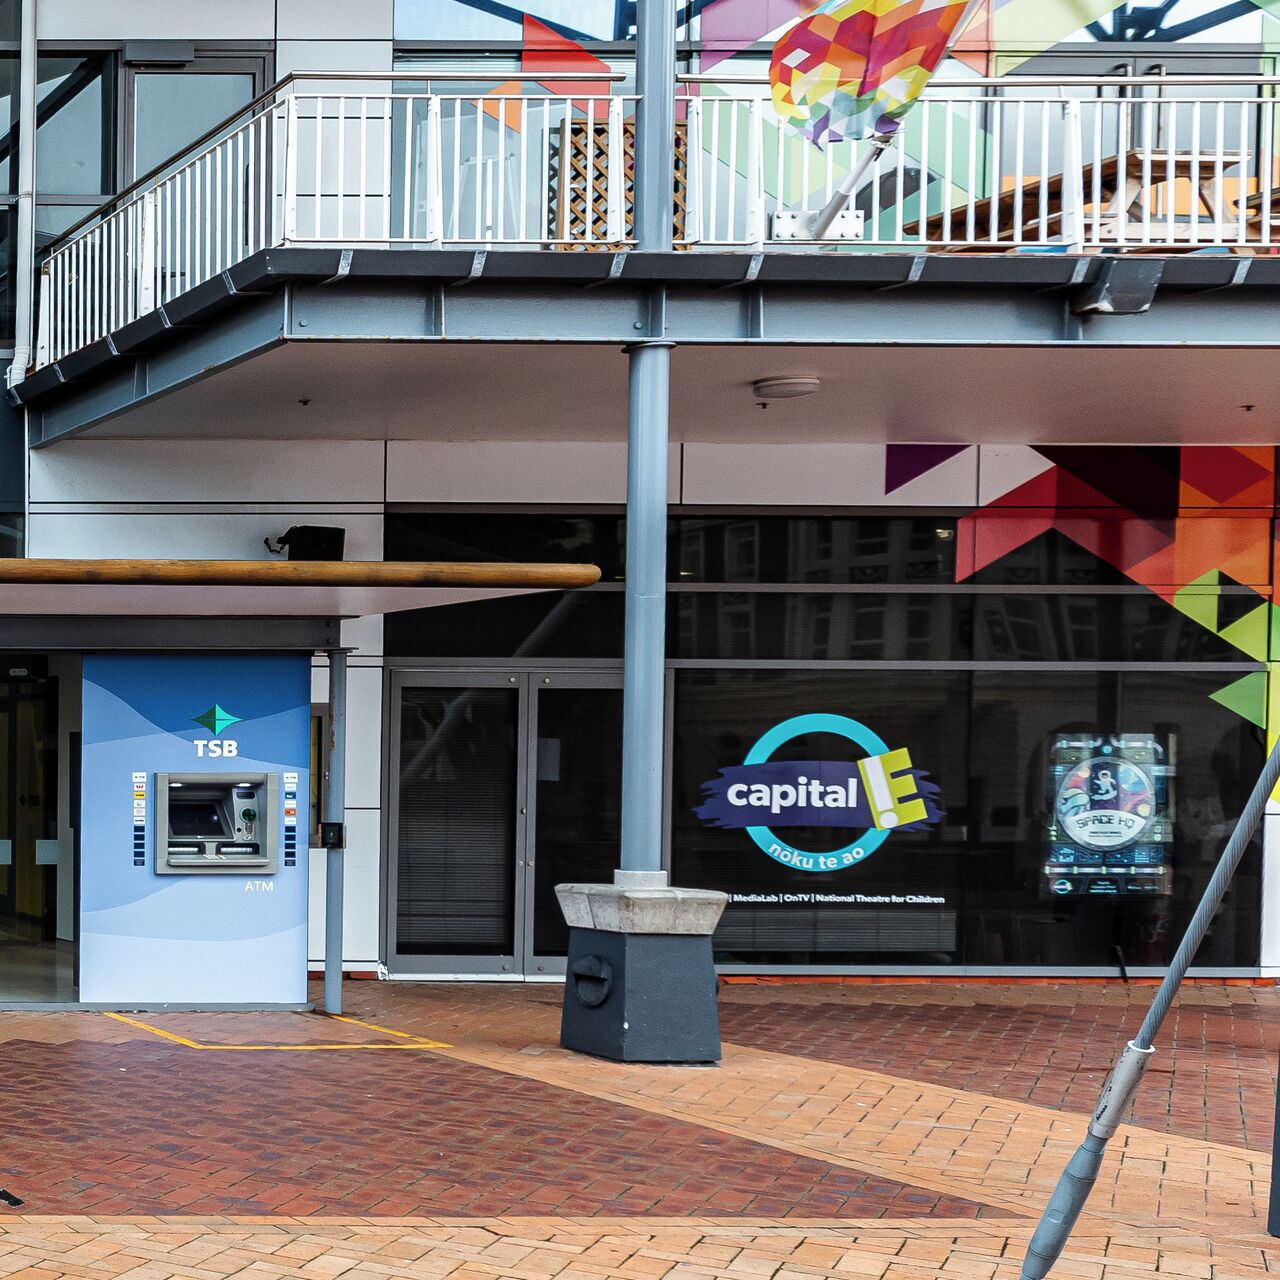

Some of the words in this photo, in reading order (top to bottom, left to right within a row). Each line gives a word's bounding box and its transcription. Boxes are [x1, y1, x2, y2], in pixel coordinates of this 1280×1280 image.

[193, 740, 238, 758] TSB
[727, 776, 857, 814] capital
[1077, 814, 1115, 829] SPACE
[1118, 816, 1136, 830] HQ
[768, 843, 814, 869] nōku
[819, 855, 837, 869] te
[842, 847, 865, 864] ao
[244, 881, 274, 891] ATM
[733, 894, 778, 902] MediaLab
[784, 894, 811, 903] OnTV
[815, 894, 854, 903] National
[856, 894, 890, 904] Theatre
[891, 894, 905, 903] for
[906, 894, 945, 904] Children
